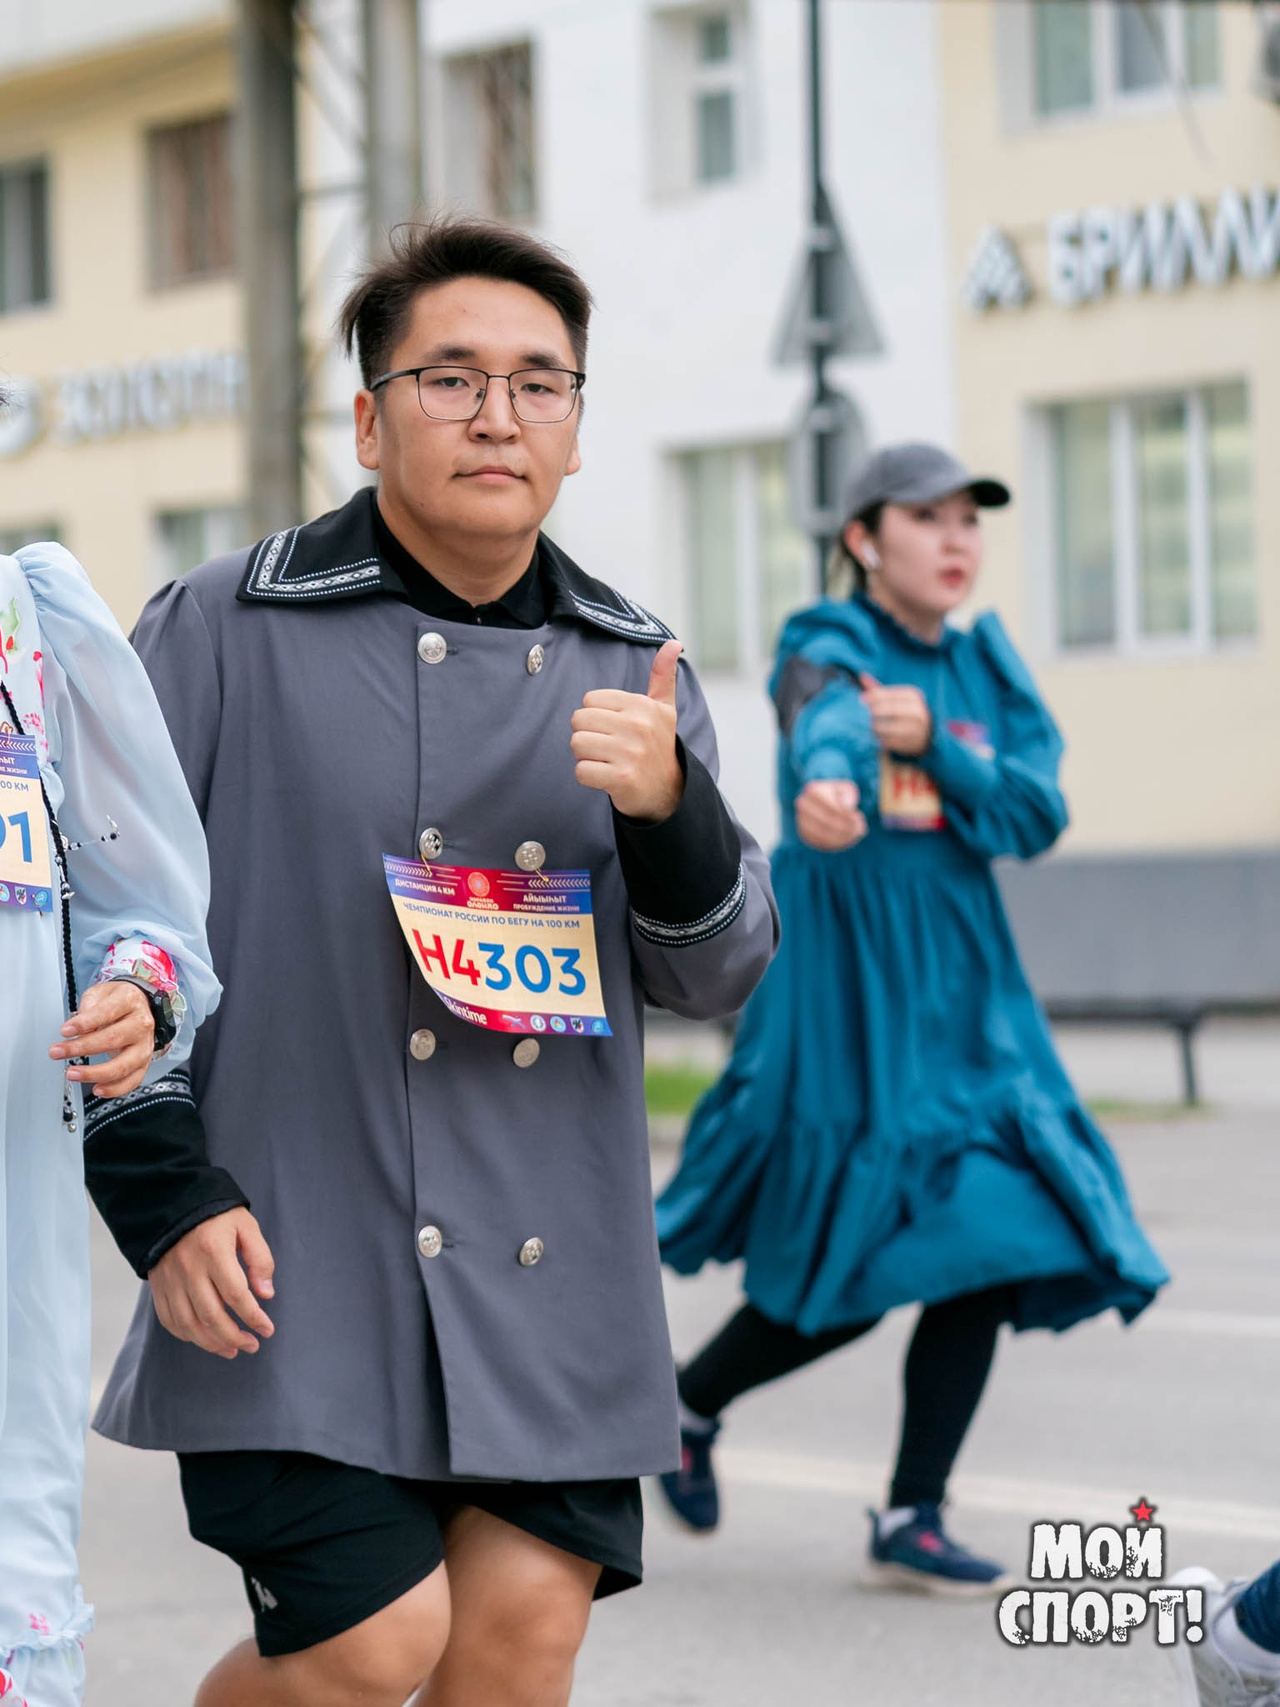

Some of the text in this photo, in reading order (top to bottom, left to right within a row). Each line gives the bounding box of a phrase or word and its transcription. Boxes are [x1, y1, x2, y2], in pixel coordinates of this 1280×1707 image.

[7, 767, 28, 775] ЖИЗНИ
[14, 782, 29, 792] КМ
[395, 878, 437, 893] ДИСТАНЦИЯ
[403, 903, 453, 918] ЧЕМПИОНАТ
[455, 912, 490, 923] РОССИИ
[492, 916, 506, 924] ПО
[508, 918, 529, 926] БЕГУ
[565, 920, 580, 928] КМ
[444, 996, 488, 1025] Skintime
